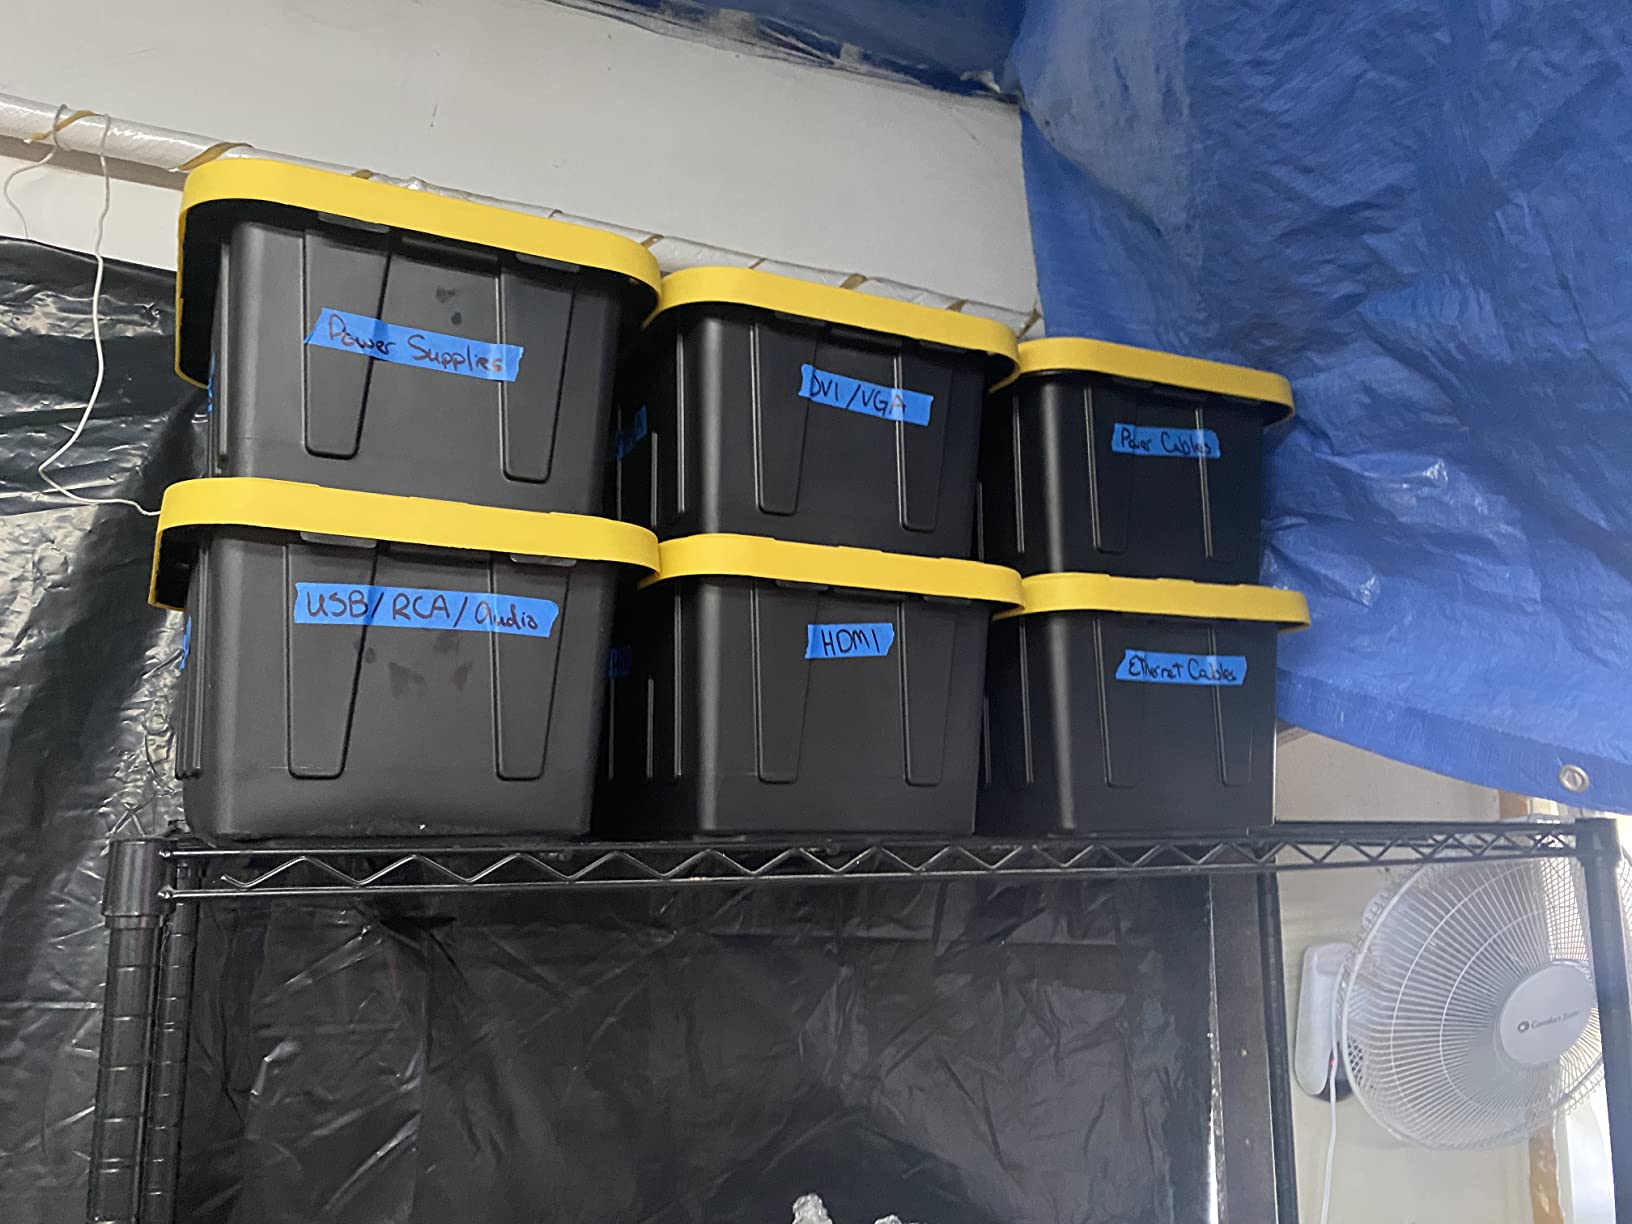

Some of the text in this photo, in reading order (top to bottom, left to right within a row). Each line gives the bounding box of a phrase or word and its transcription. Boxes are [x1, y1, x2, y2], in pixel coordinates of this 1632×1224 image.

[328, 313, 504, 373] Power Supplies
[810, 374, 906, 417] DVI/VGA
[1120, 426, 1212, 456] Power Cables
[821, 628, 880, 656] HDMI
[1187, 657, 1237, 681] Cables
